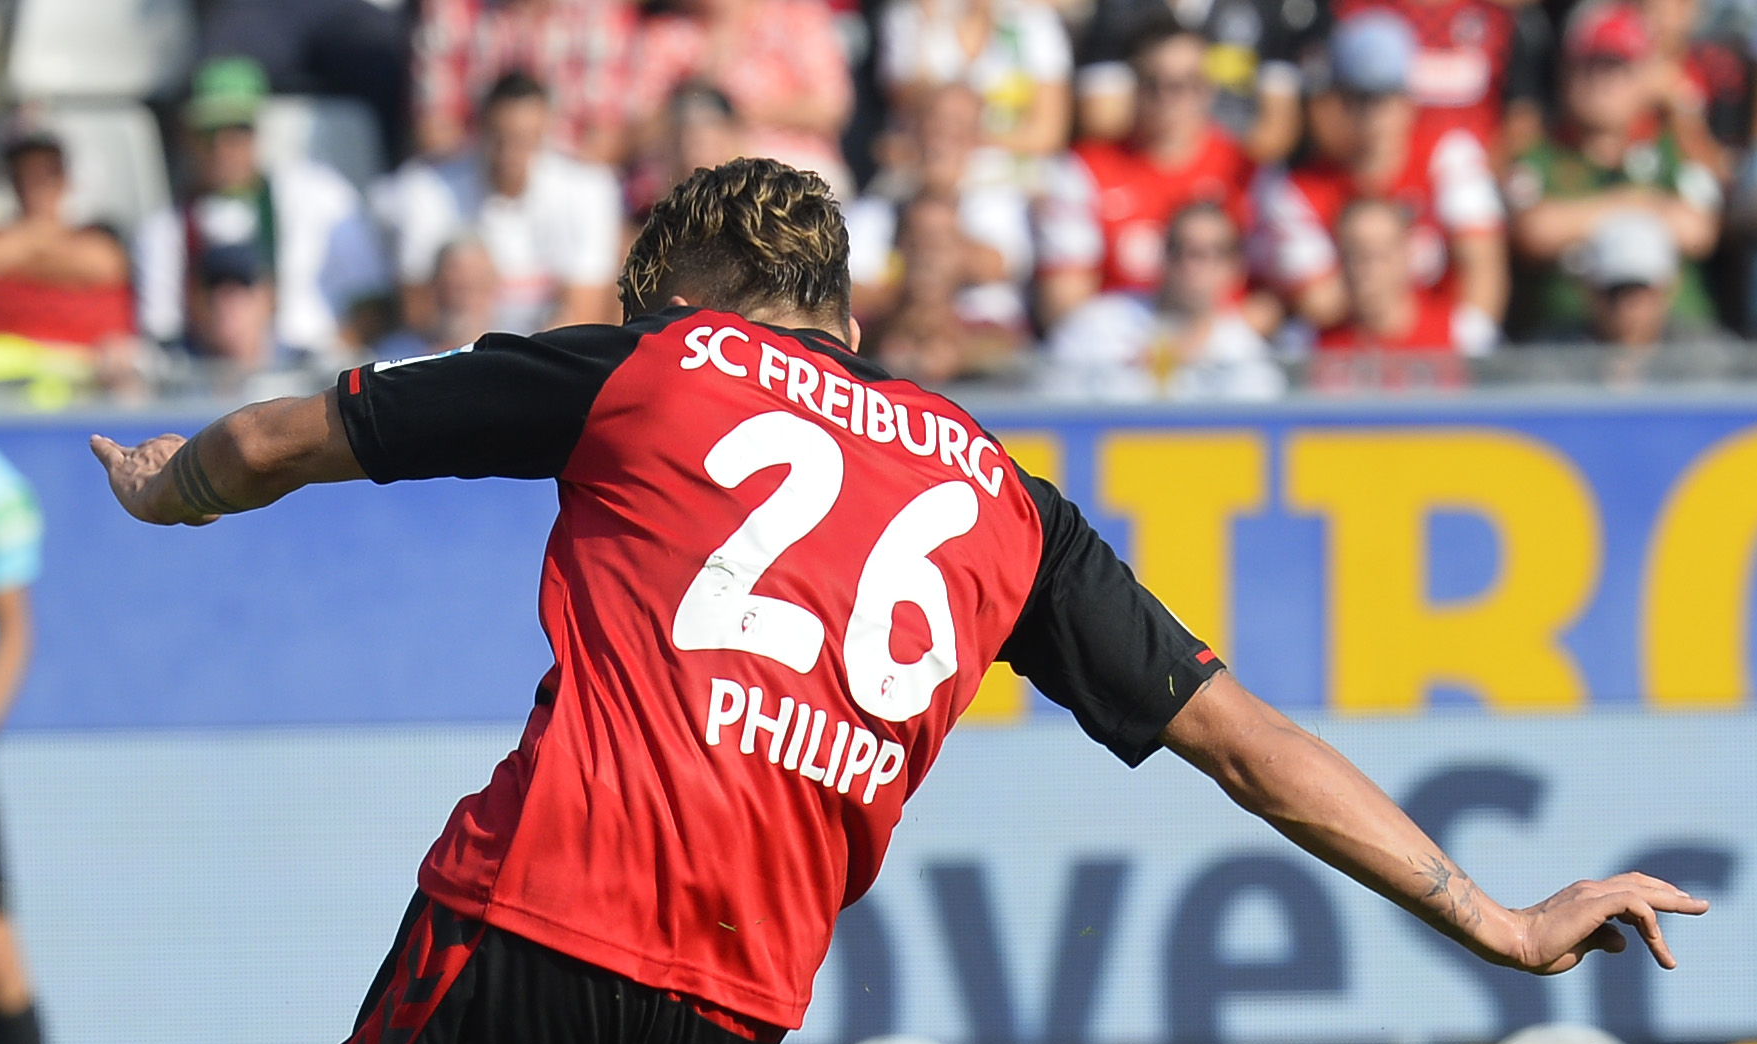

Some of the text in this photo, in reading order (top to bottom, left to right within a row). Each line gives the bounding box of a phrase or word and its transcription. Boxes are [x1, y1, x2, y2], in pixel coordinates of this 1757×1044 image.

[679, 325, 1005, 498] SC FREIBURG
[671, 410, 980, 723] 26
[705, 677, 906, 805] PHILIPP
